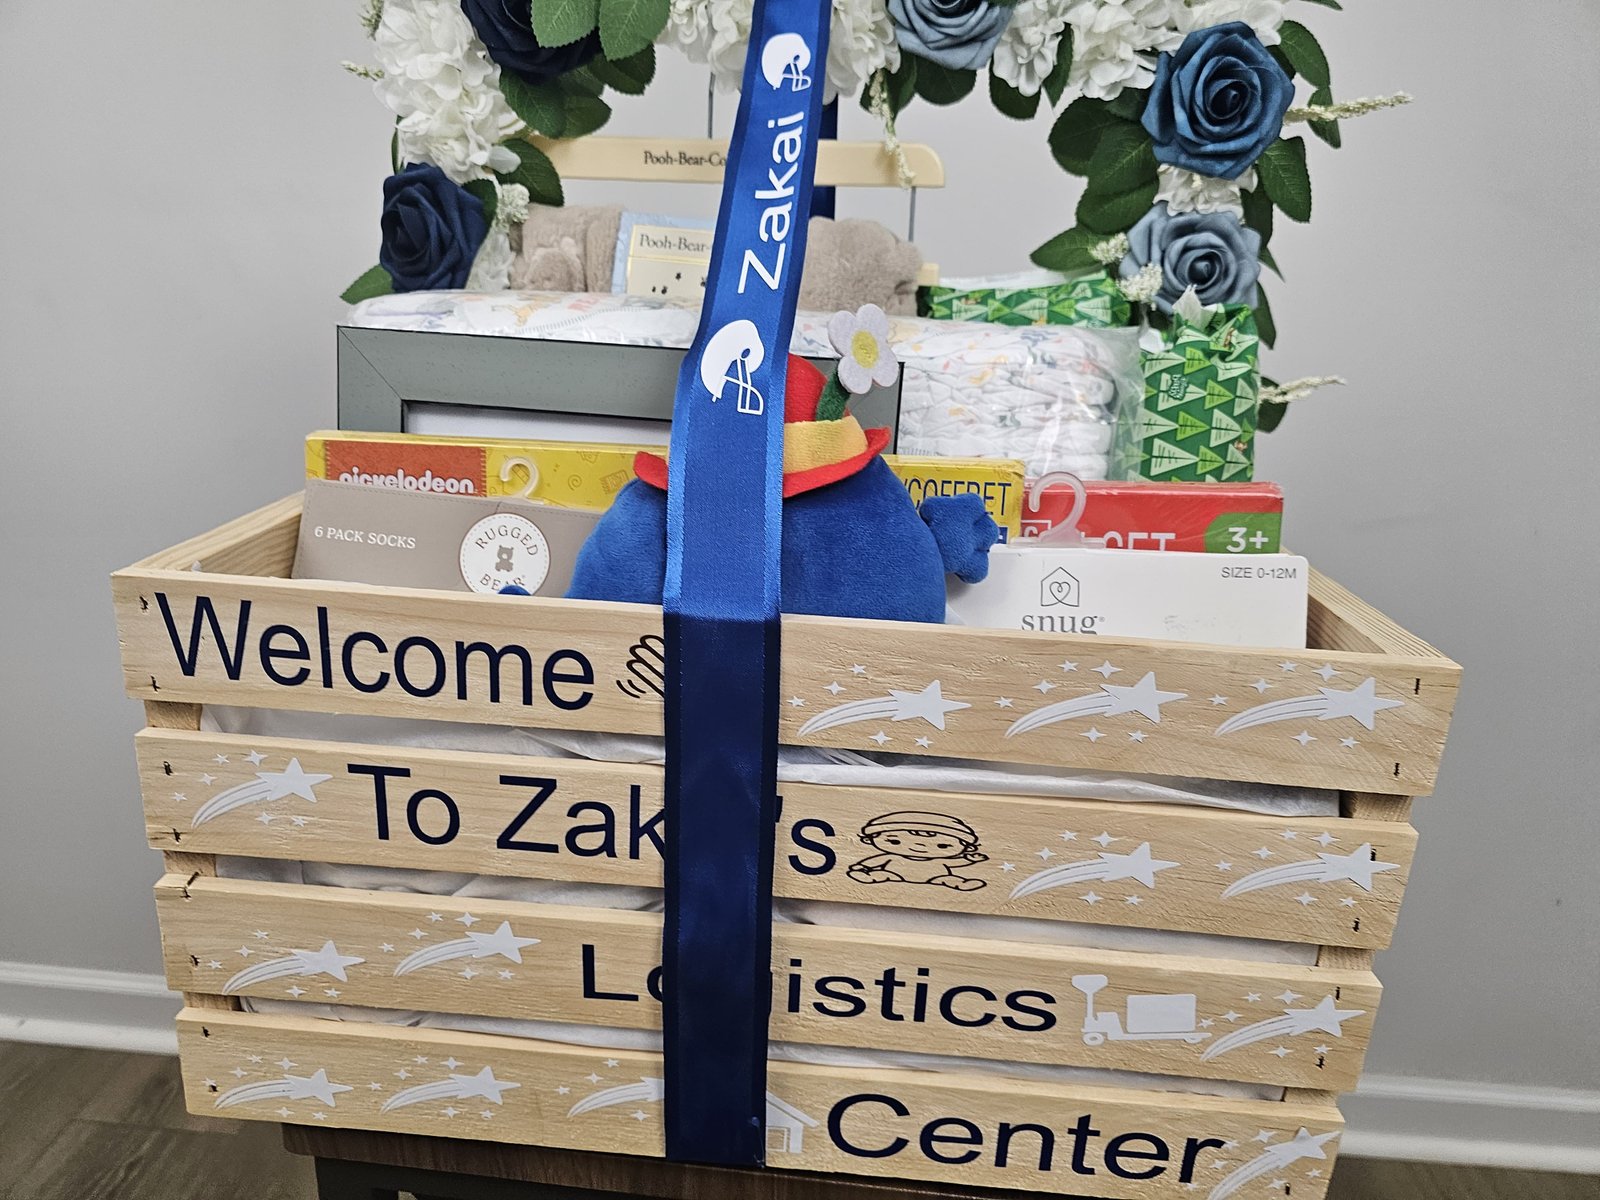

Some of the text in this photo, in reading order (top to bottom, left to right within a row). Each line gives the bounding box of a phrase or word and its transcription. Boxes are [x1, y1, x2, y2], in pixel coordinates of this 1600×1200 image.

[738, 111, 805, 295] Zakai
[339, 465, 475, 494] nickelodeon
[314, 525, 416, 549] 6 PACK SOCKS
[475, 524, 539, 556] RUGGED
[1226, 526, 1269, 553] 3+
[480, 573, 526, 591] BER
[1221, 566, 1297, 579] SIZE 0-12M
[1021, 614, 1098, 635] snug
[154, 591, 595, 711] Welcome
[347, 763, 837, 876] To Zak's
[582, 943, 1058, 1034] Listics
[827, 1093, 1226, 1184] Center
